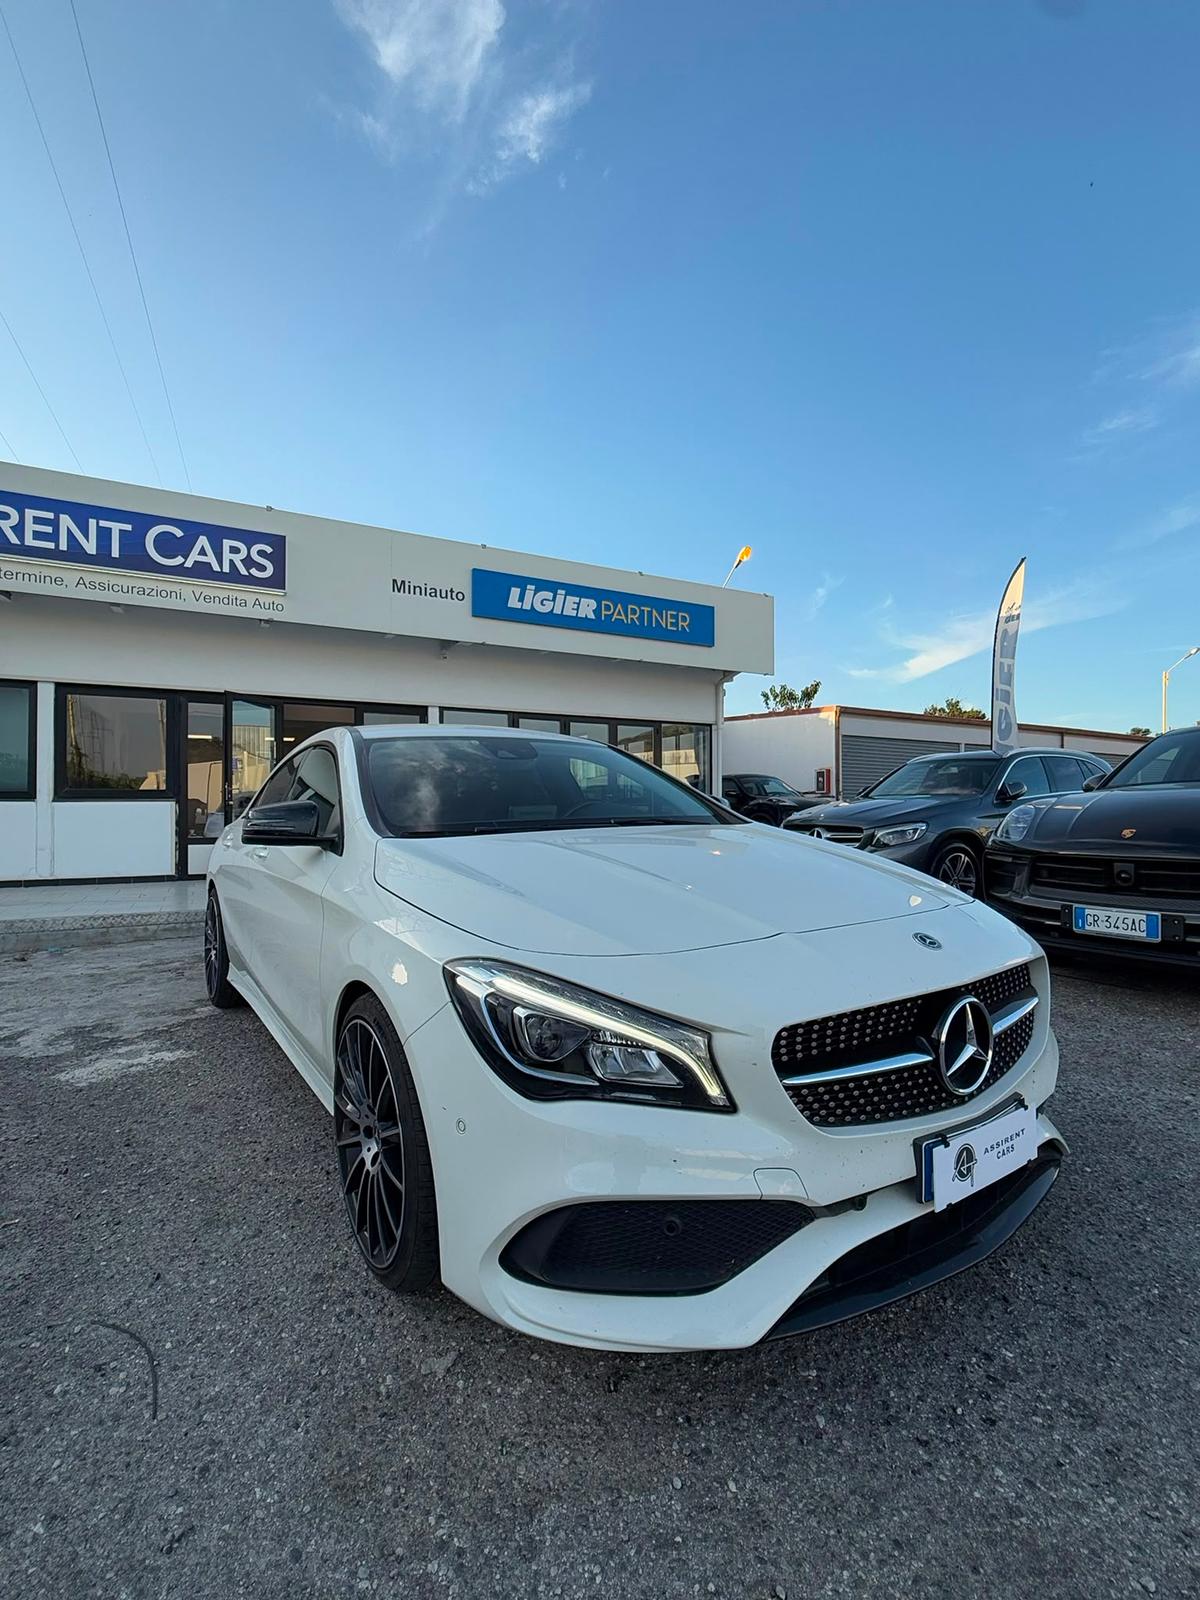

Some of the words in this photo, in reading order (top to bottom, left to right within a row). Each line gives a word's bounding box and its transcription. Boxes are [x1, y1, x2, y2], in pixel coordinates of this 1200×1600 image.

[0, 505, 133, 558] RENT
[145, 524, 274, 579] CARS
[75, 576, 187, 602] Assicurazioni,
[192, 590, 247, 608] Vendita
[252, 597, 284, 612] Auto
[391, 578, 465, 602] Miniauto
[601, 600, 690, 632] PARTNER
[983, 1128, 1026, 1155] ASSIRENT
[996, 1144, 1015, 1160] CARS
